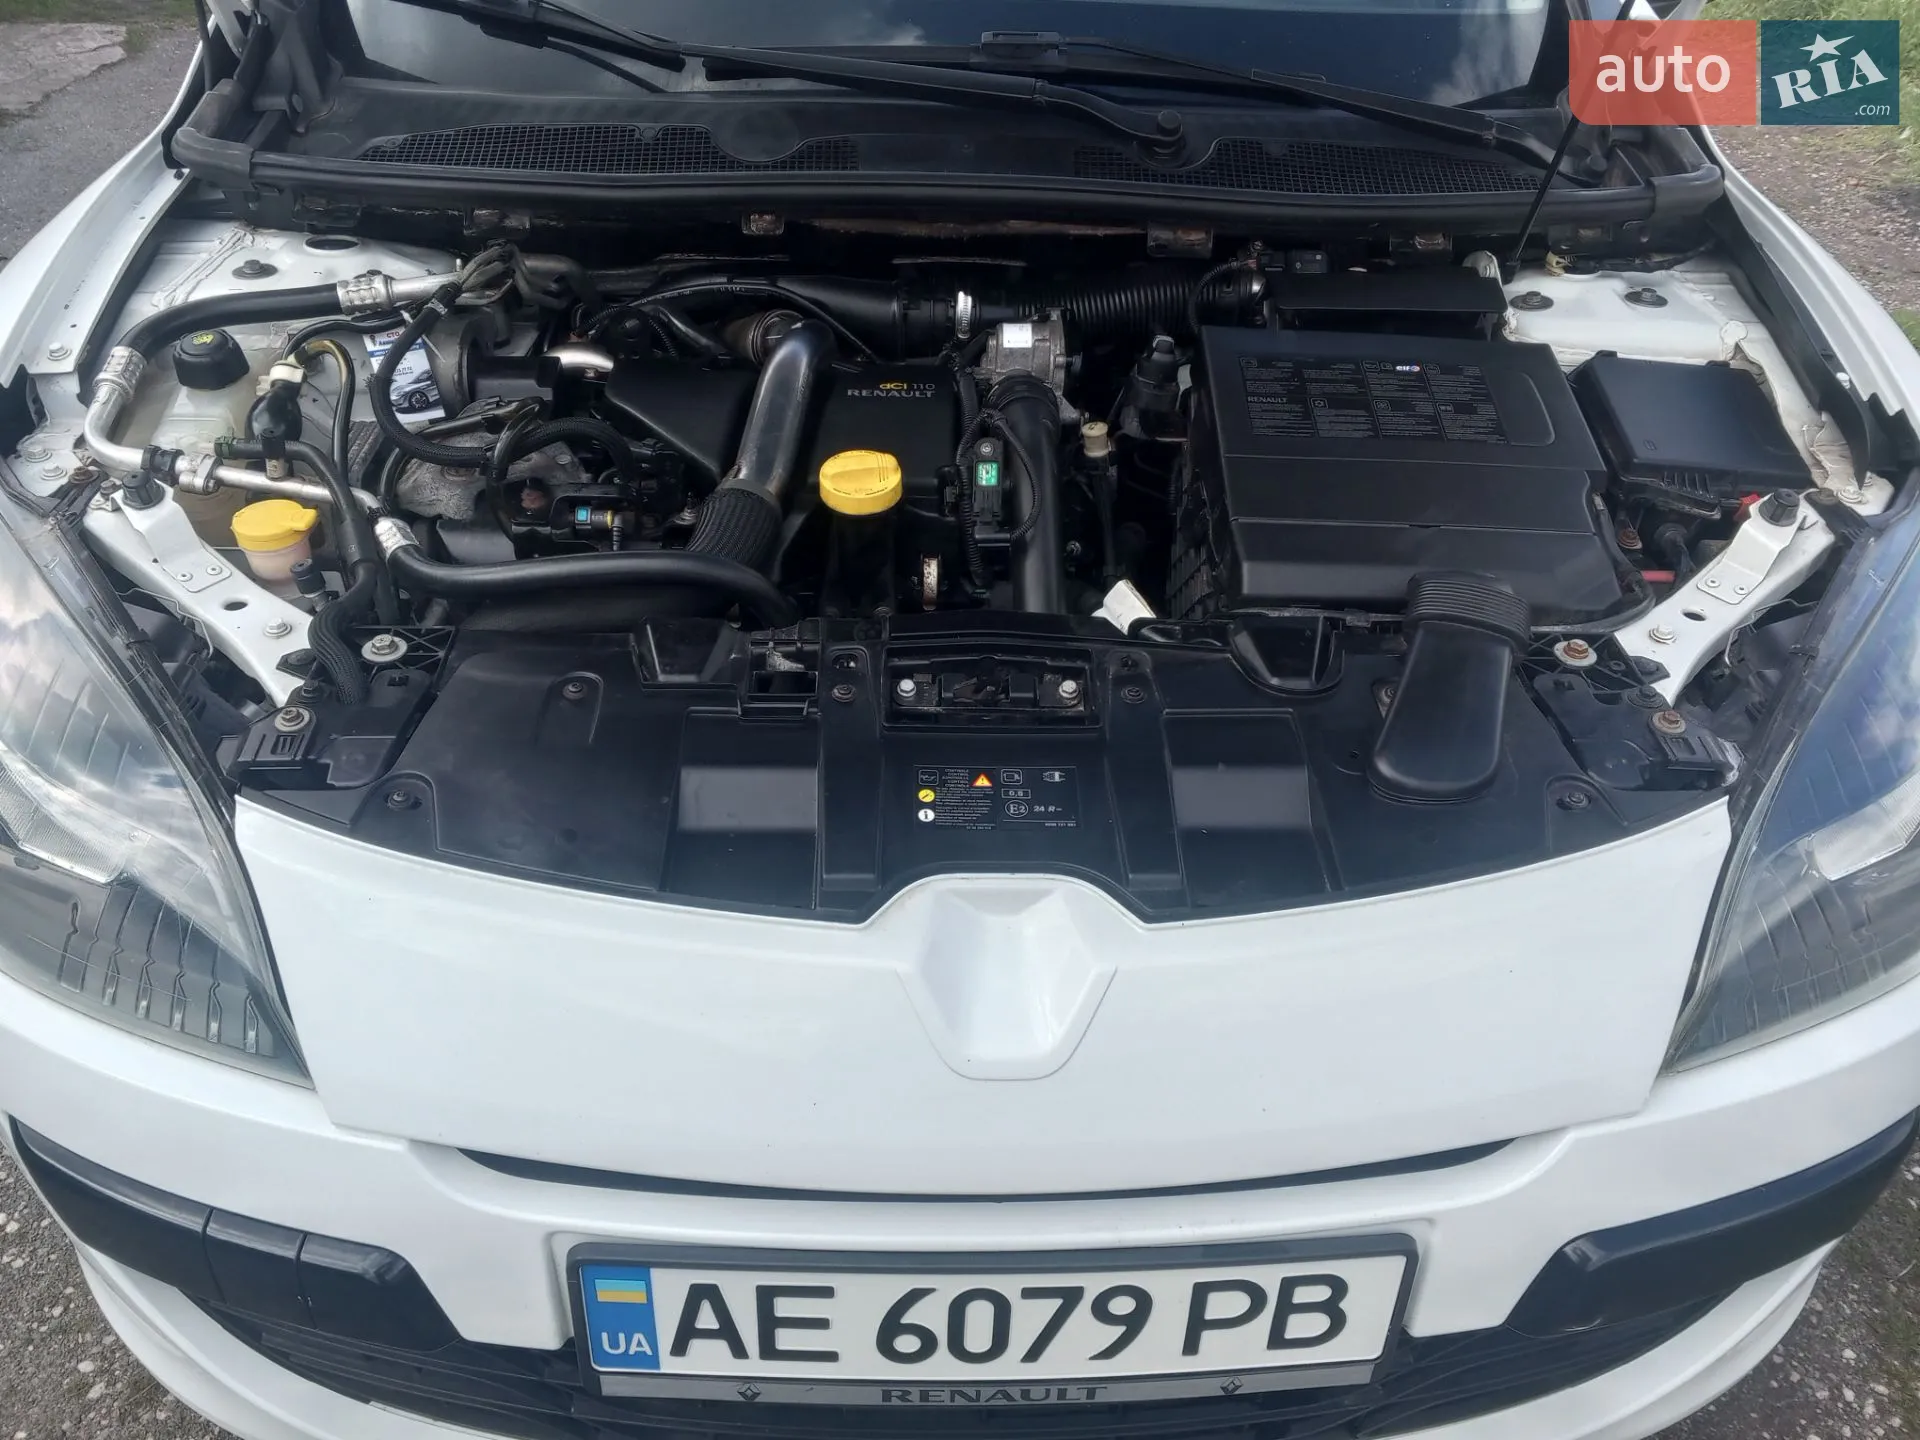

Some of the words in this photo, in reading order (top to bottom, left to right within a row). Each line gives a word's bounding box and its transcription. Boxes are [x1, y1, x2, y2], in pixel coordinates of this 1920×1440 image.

[847, 389, 936, 398] RENAULT
[1247, 396, 1288, 404] RENAULT
[1010, 803, 1026, 814] E2
[669, 1283, 840, 1363] AE
[875, 1284, 1153, 1365] 6079
[1181, 1273, 1349, 1357] PB
[601, 1332, 653, 1356] UA
[881, 1386, 1108, 1403] RENAULT
